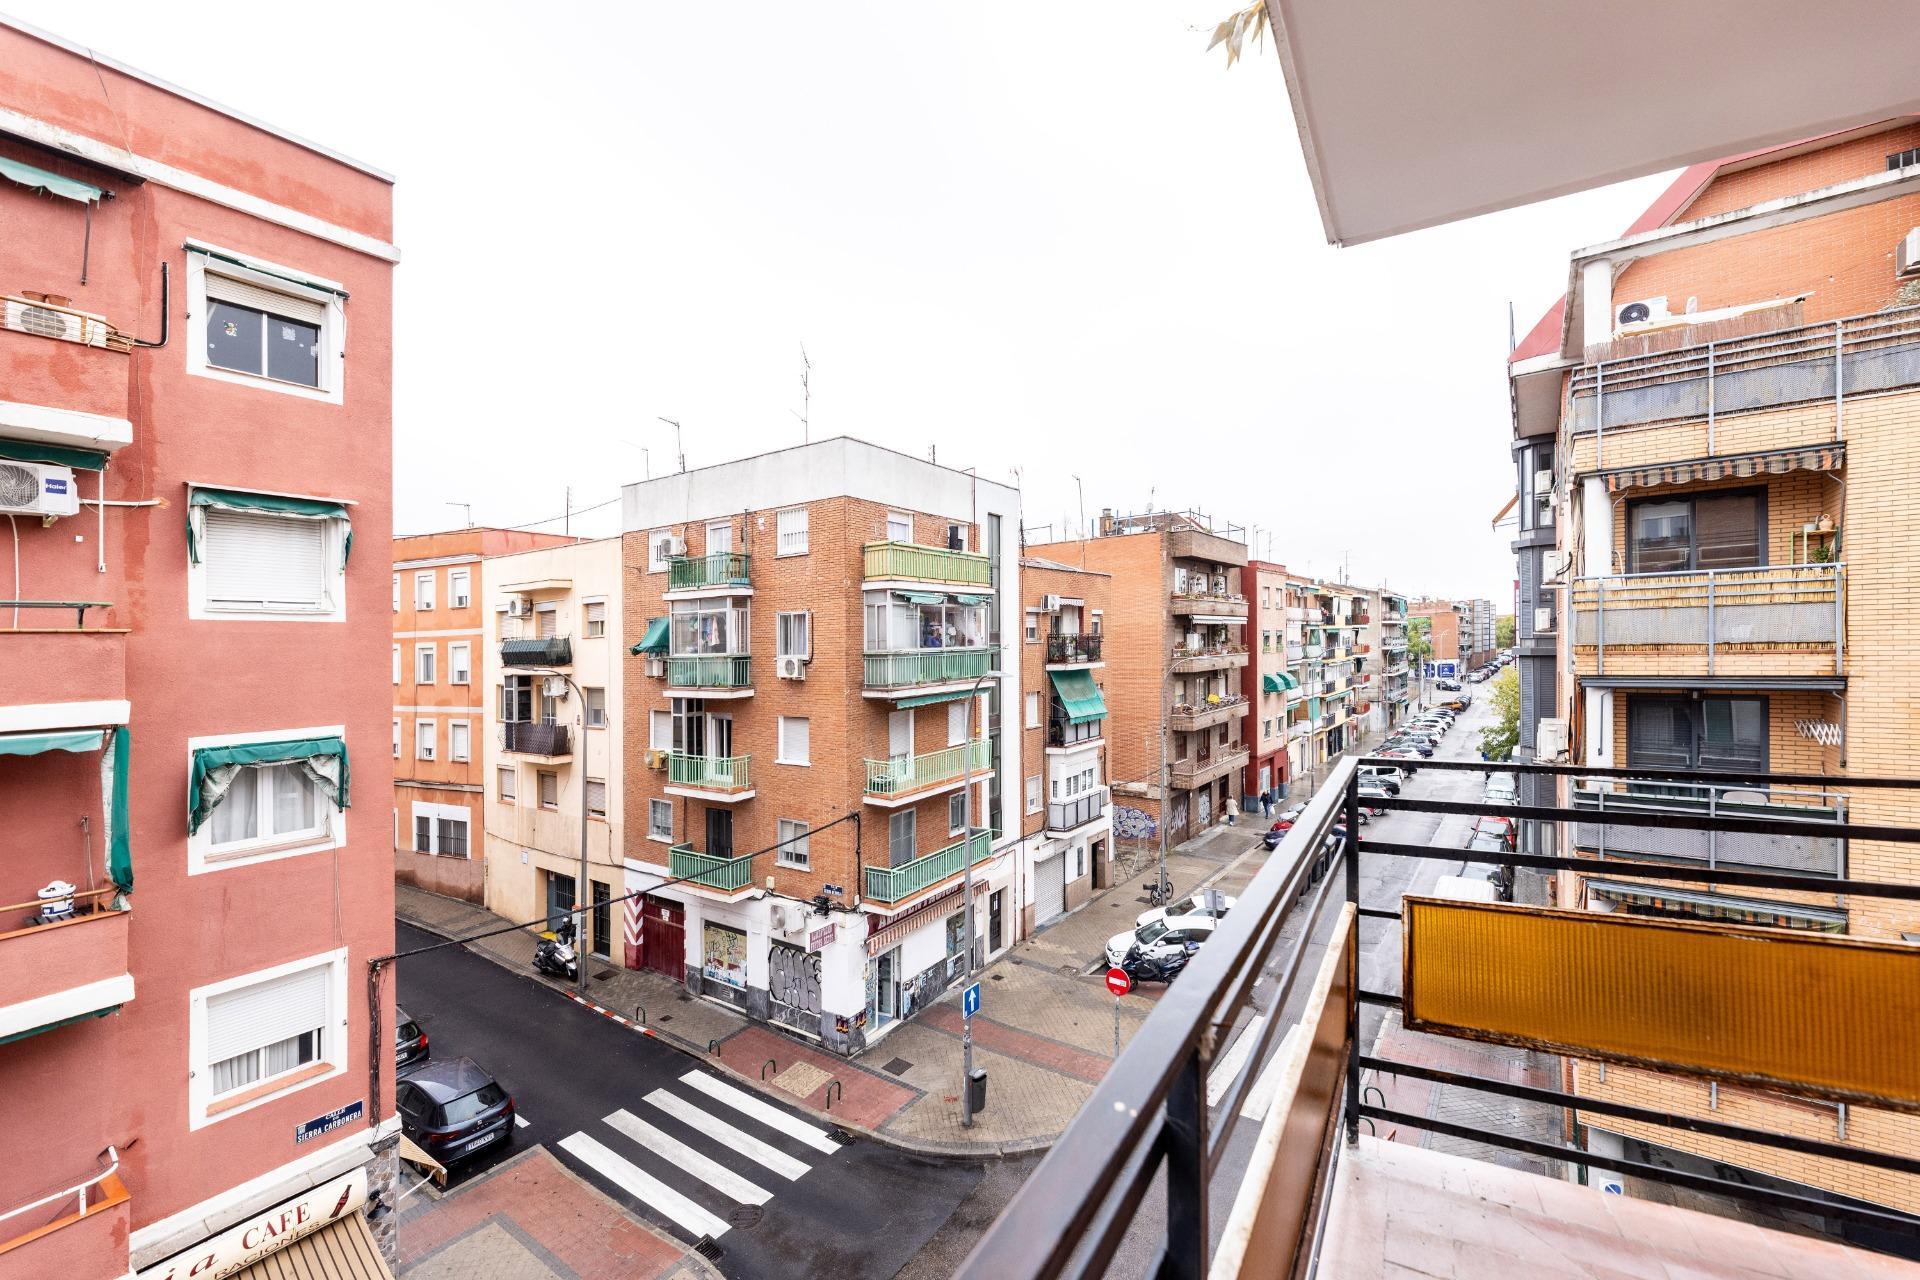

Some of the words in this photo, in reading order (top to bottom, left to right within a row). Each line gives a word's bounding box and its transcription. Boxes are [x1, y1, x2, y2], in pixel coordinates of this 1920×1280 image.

[45, 483, 67, 491] Haier
[297, 1126, 323, 1143] SIERRA
[324, 1110, 362, 1133] CARBONERA
[325, 1107, 346, 1120] CALLE
[242, 1202, 311, 1250] CAFE
[214, 1221, 320, 1280] RACIONES
